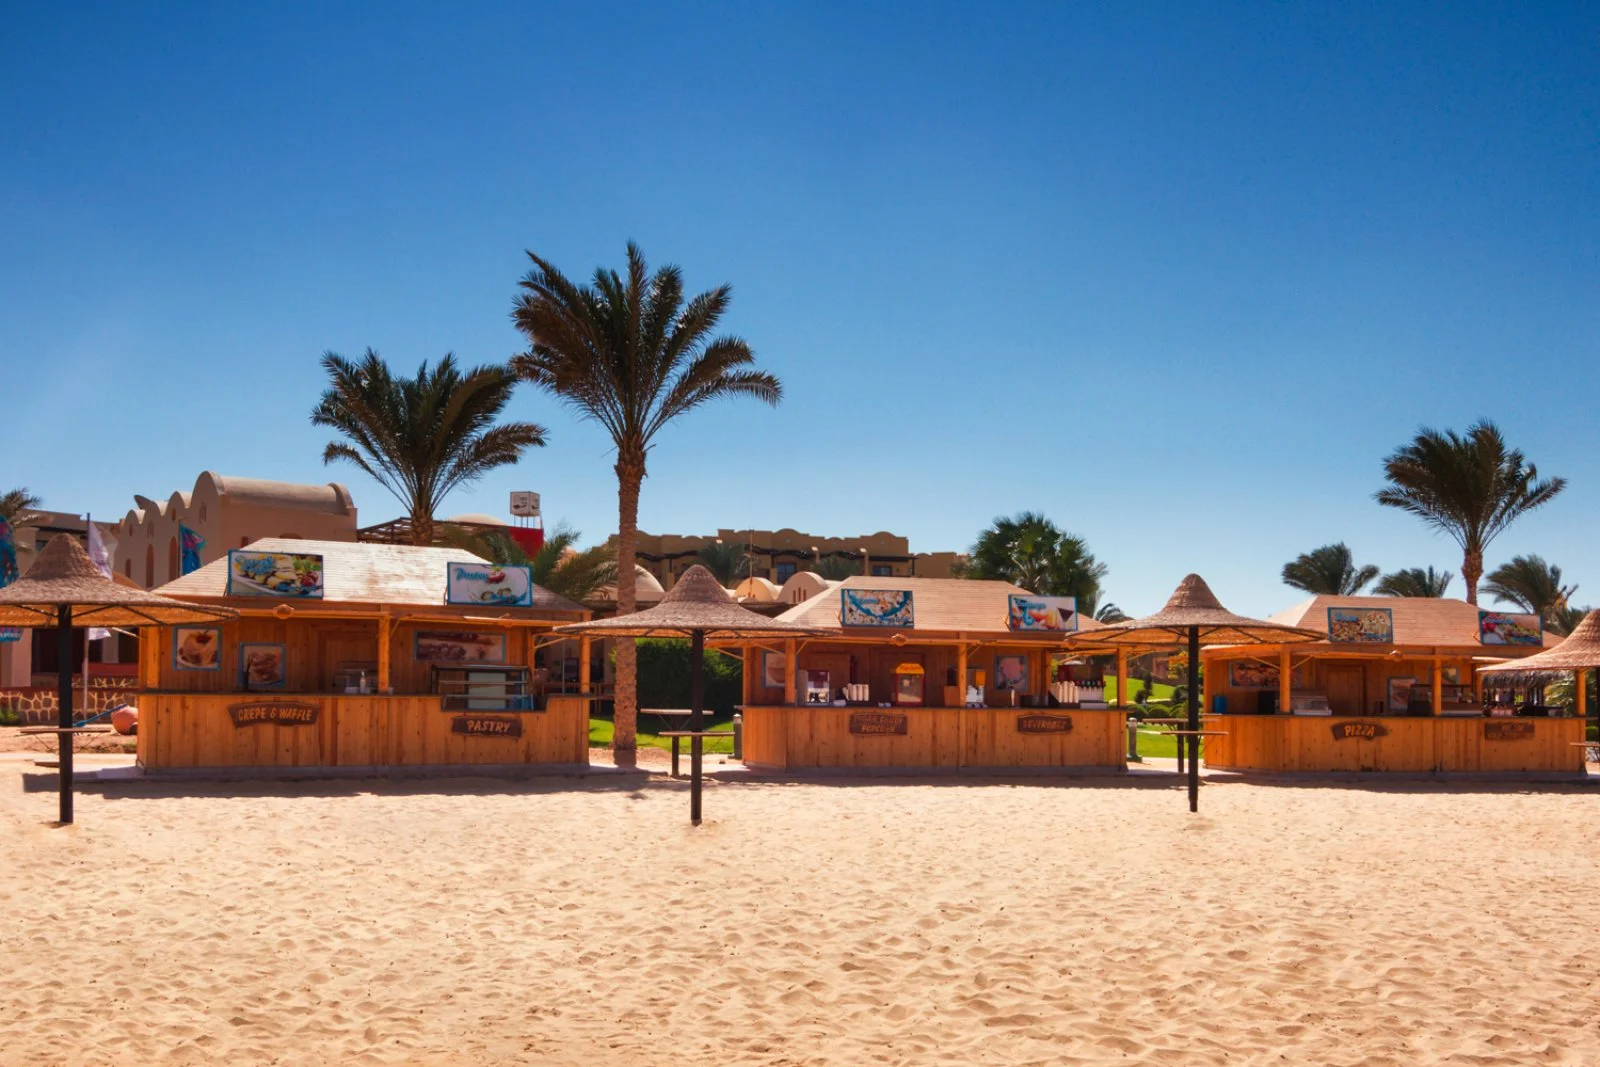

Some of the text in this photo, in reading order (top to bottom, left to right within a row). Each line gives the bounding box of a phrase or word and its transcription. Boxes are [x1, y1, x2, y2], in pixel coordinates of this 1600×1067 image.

[238, 707, 266, 720] CREPE
[280, 708, 312, 721] WAFFLE
[466, 720, 511, 733] PASTRY
[1344, 724, 1375, 737] PIZZA
